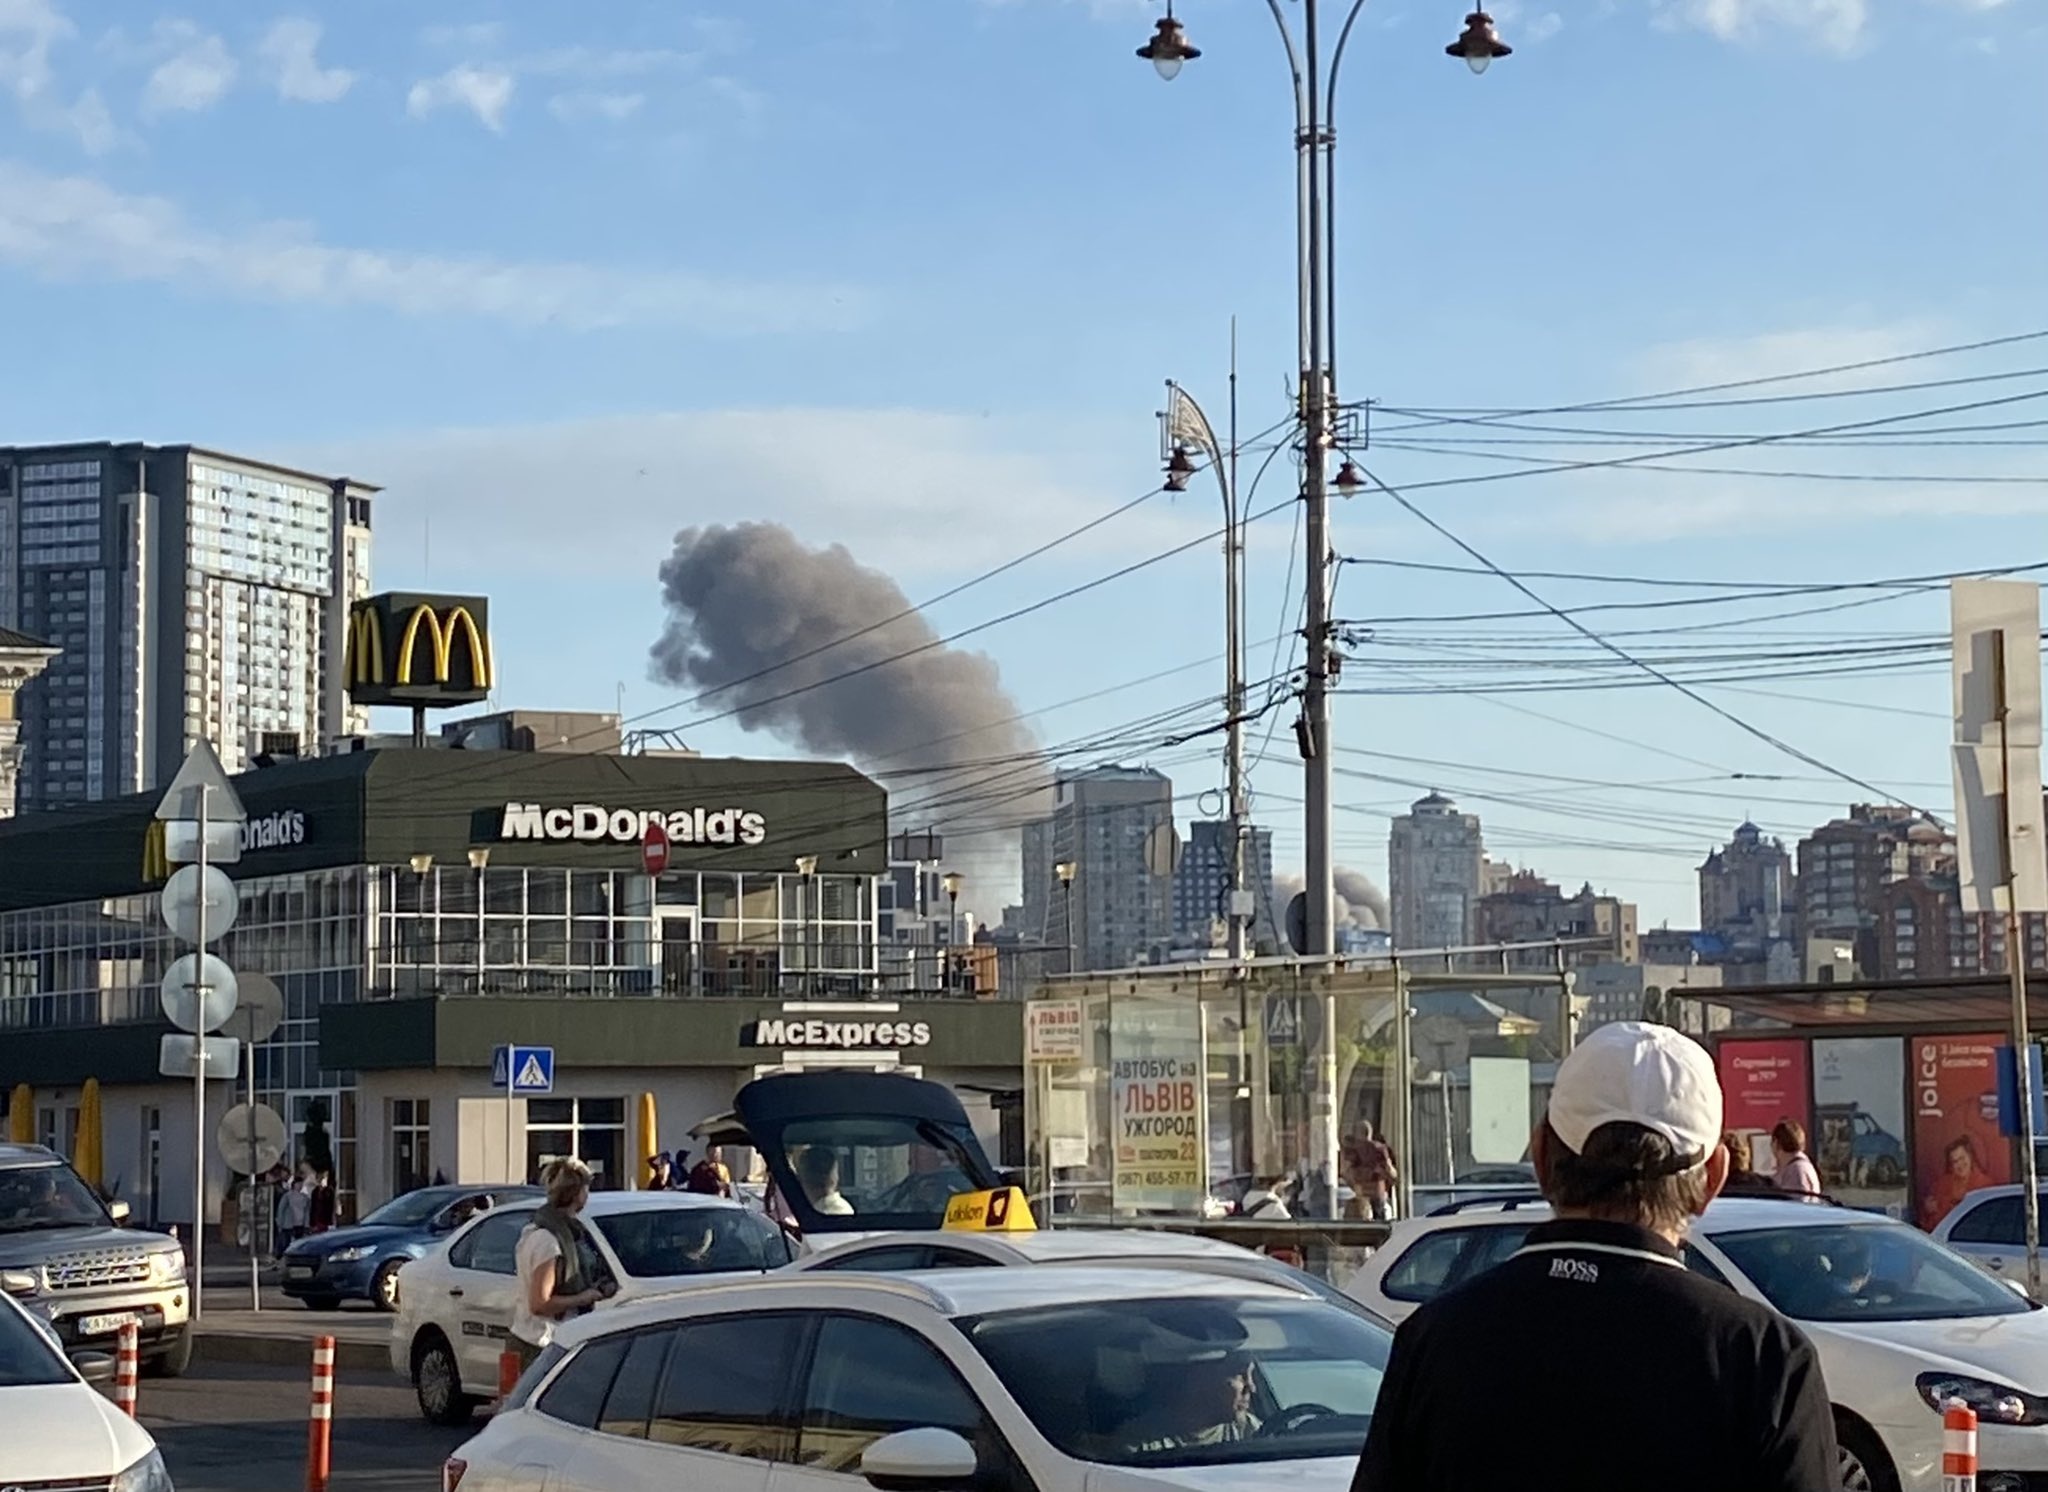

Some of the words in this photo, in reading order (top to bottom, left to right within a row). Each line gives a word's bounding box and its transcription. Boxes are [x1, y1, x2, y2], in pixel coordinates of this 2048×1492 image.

[501, 802, 766, 844] McDonald's
[756, 1020, 931, 1048] McExpress
[1114, 1059, 1177, 1079] АВТОБУС
[1180, 1062, 1197, 1077] на
[1918, 1045, 1943, 1118] joice
[1124, 1081, 1195, 1114] ЛЬВІВ
[1124, 1116, 1197, 1140] УЖГОРОД
[1180, 1142, 1196, 1162] 23
[1551, 1258, 1599, 1278] BOSS
